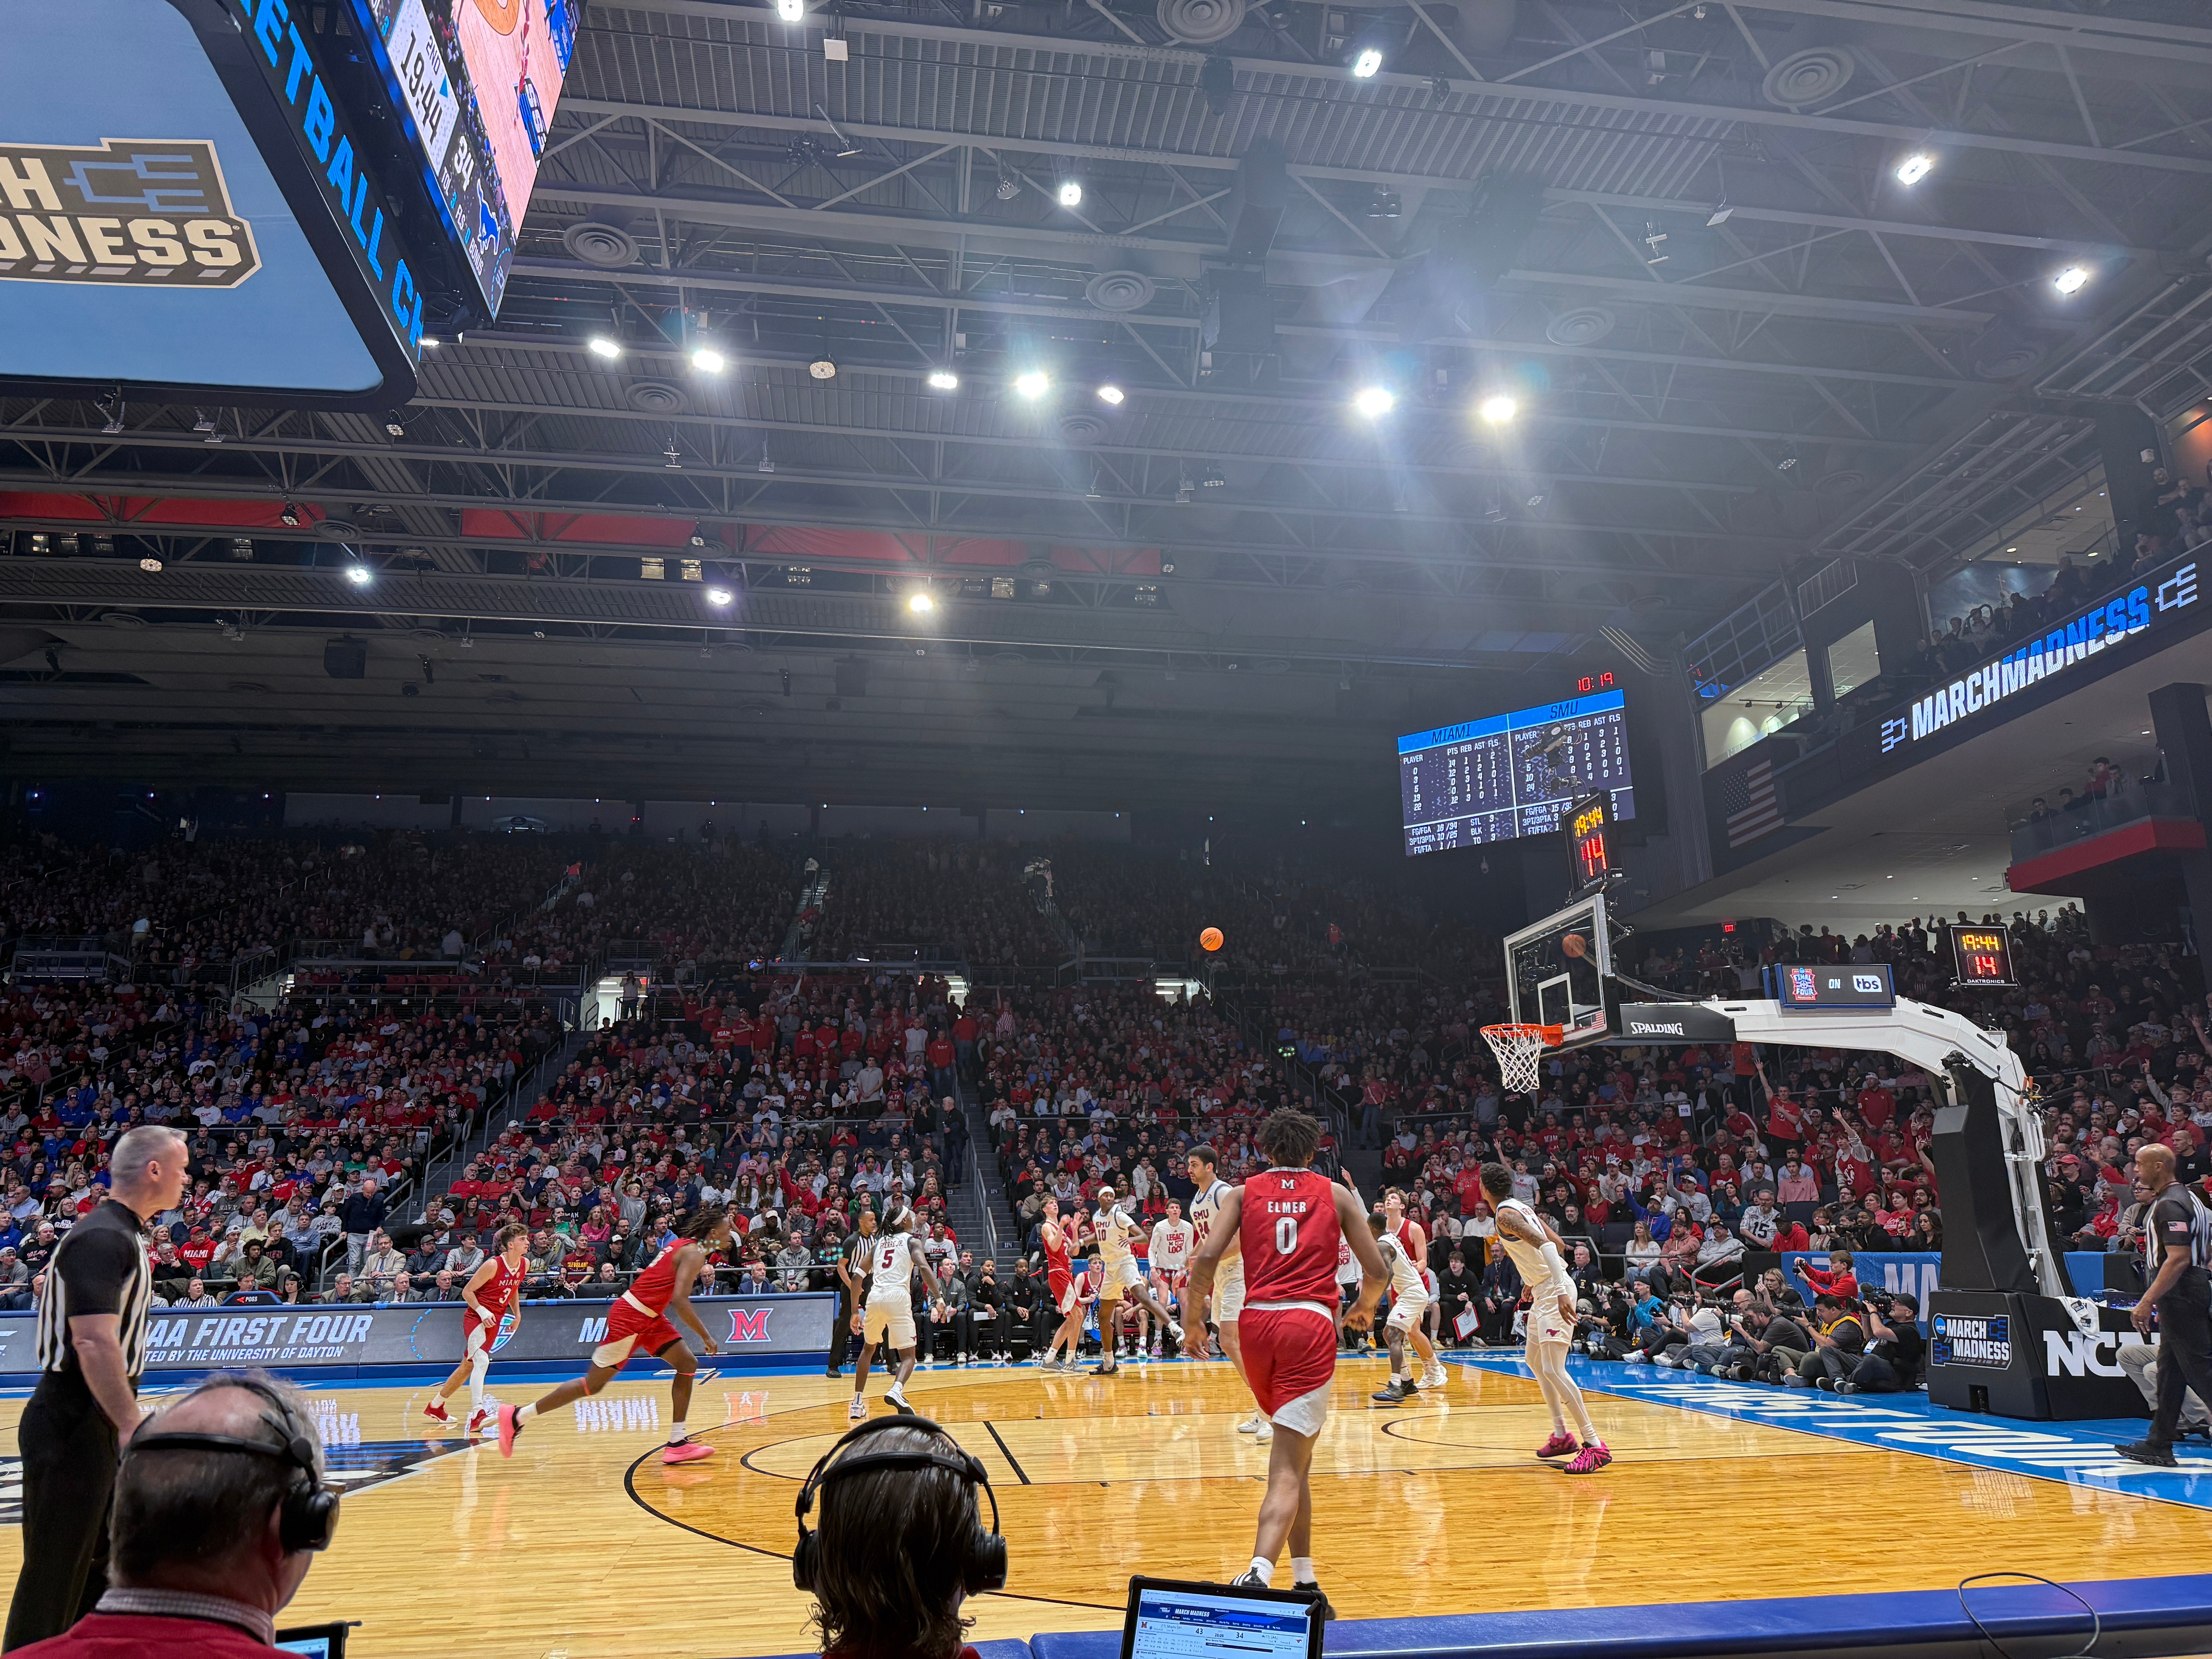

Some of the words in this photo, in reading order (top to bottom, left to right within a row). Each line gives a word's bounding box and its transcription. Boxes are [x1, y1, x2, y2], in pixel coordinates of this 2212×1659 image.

[426, 35, 441, 76] 2ND
[400, 29, 443, 145] 19:44
[240, 0, 383, 282] ETBALL
[454, 136, 474, 192] 34
[0, 157, 63, 210] H
[441, 167, 451, 196] TOL
[455, 204, 466, 230] FLS
[469, 237, 484, 276] BONUS
[1550, 701, 1578, 719] SMU
[1432, 724, 1471, 744] MIAMI
[1515, 731, 1537, 742] PLAYER
[1578, 720, 1591, 728] REB
[1594, 716, 1606, 726] AST
[1609, 714, 1621, 723] FLS
[1584, 733, 1588, 741] 1
[1599, 729, 1604, 737] 3
[1614, 726, 1618, 735] 1
[1403, 754, 1423, 764] PLAYER
[1475, 742, 1485, 750] AST
[1488, 739, 1499, 747] FLS
[1585, 743, 1589, 751] 0
[1601, 740, 1605, 748] 2
[1615, 737, 1619, 745] 1
[1586, 752, 1590, 761] 2
[1602, 749, 1606, 757] 3
[1616, 747, 1621, 755] 0
[1449, 759, 1456, 768] 14
[1526, 773, 1534, 782] 10
[1571, 766, 1576, 774] 8
[1587, 763, 1592, 771] 6
[1602, 759, 1607, 768] 0
[1617, 757, 1622, 765] 0
[1449, 769, 1456, 777] 12
[1527, 783, 1535, 792] 24
[1588, 772, 1593, 780] 4
[1604, 769, 1609, 778] 0
[1619, 767, 1623, 775] 1
[1414, 803, 1422, 811] 22
[1451, 796, 1458, 804] 12
[1611, 793, 1616, 802] 3
[1525, 805, 1547, 816] FG/FGA
[1551, 804, 1559, 812] 15
[1612, 803, 1618, 811] 0
[1522, 814, 1552, 826] 3PT/3PTA
[1554, 813, 1559, 821] 3
[1613, 812, 1618, 821] 3
[1409, 835, 1436, 845] 3PT/3PTA
[1437, 833, 1444, 841] 10
[1471, 827, 1482, 836] BLK
[1491, 824, 1495, 832] 2
[1412, 826, 1431, 836] FG/FGA
[1470, 817, 1481, 826] STL
[1528, 825, 1547, 835] FT/FTA
[1555, 823, 1559, 831] 1
[1414, 845, 1432, 854] FT/FTA
[1440, 842, 1444, 850] 1
[1473, 836, 1481, 845] TO
[1585, 833, 1607, 877] 14
[1962, 934, 2000, 951] 19:44
[1975, 956, 1997, 975] 14
[1793, 974, 1812, 982] FINAL
[1829, 979, 1841, 989] ON
[1856, 978, 1879, 989] tbs
[1631, 1022, 1685, 1036] SPALDING
[1281, 1179, 1295, 1190] M
[1193, 1209, 1209, 1220] SMU
[1268, 1201, 1307, 1214] ELMER
[1098, 1230, 1106, 1242] 10
[1166, 1233, 1185, 1241] LEGACY
[1198, 1220, 1210, 1239] 24
[1276, 1217, 1297, 1255] 0
[1752, 1221, 1769, 1238] 15
[184, 1249, 208, 1258] MIAMI
[1168, 1246, 1183, 1254] LOCK
[882, 1249, 895, 1269] 5
[499, 1288, 512, 1304] 3
[146, 1319, 189, 1348] AA
[192, 1317, 289, 1348] FIRST
[288, 1315, 374, 1345] FOUR
[725, 1308, 774, 1343] M
[1947, 1319, 1987, 1339] MARCH
[144, 1350, 166, 1362] TED
[167, 1349, 185, 1362] BY
[186, 1348, 208, 1361] THE
[213, 1346, 279, 1361] UNIVERSITY
[280, 1346, 296, 1359] OF
[297, 1345, 344, 1359] DAYTON
[1953, 1338, 2009, 1361] MADNESS
[2043, 1330, 2161, 1377] NC
